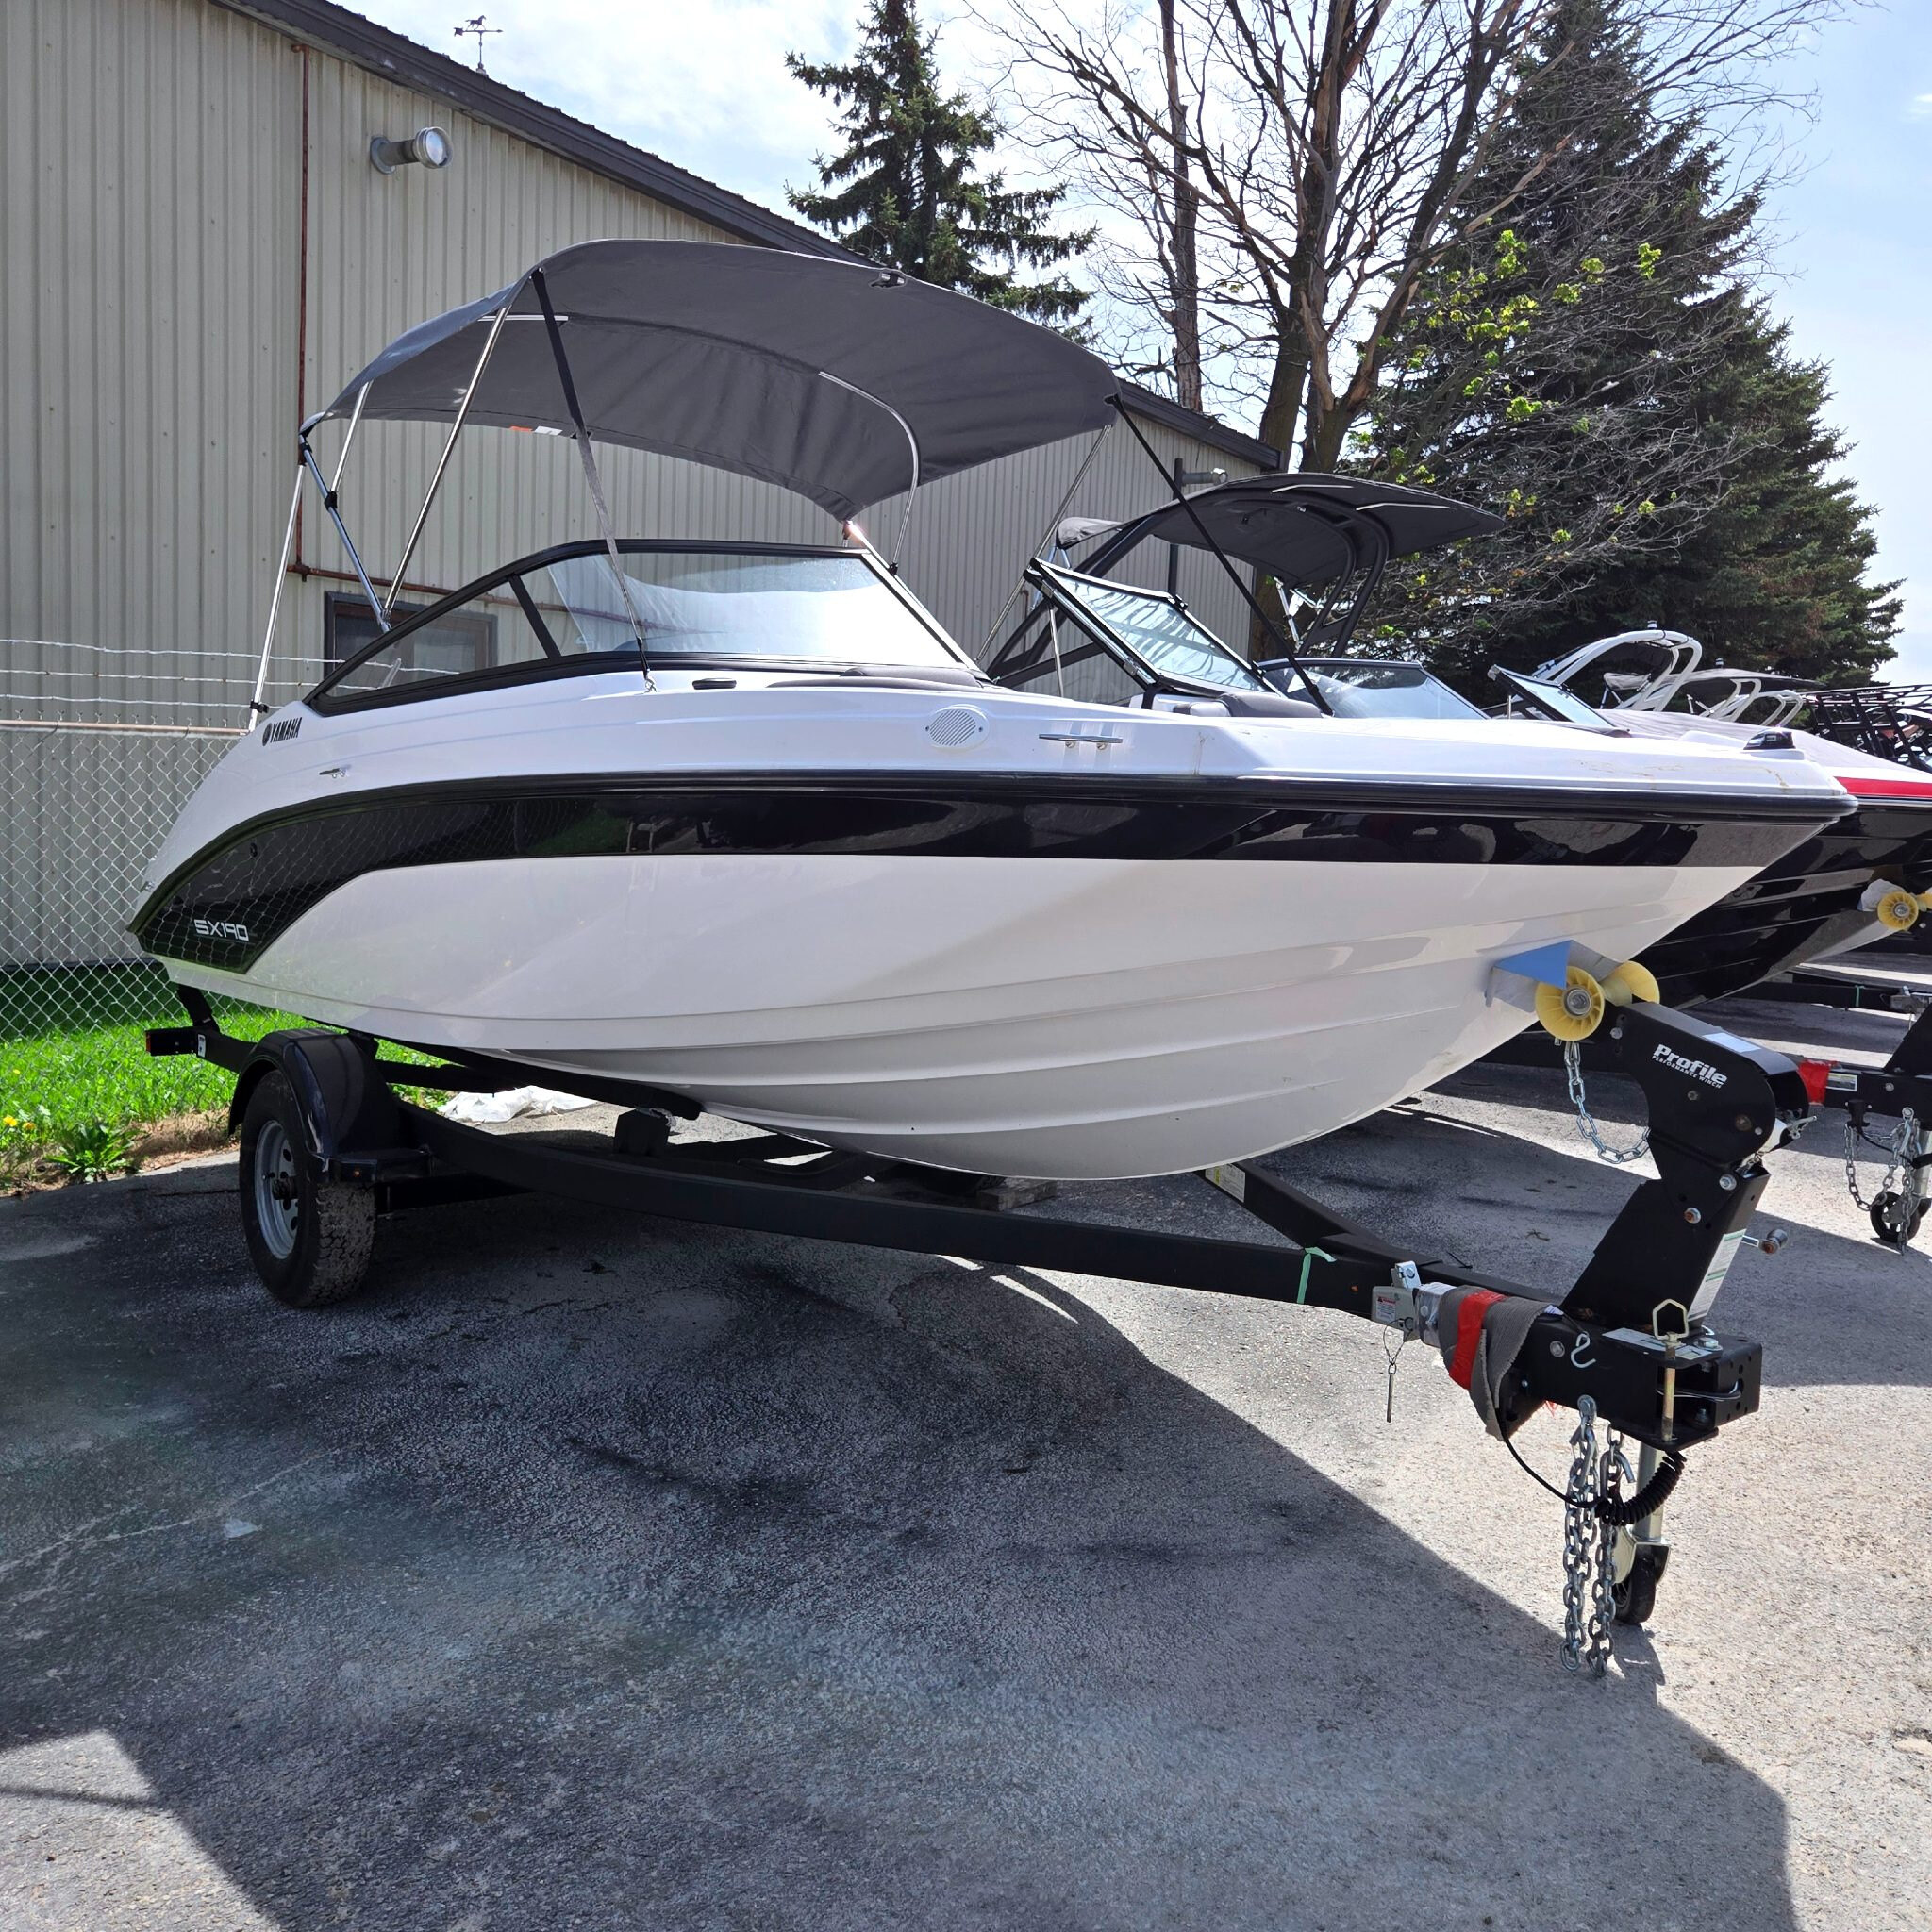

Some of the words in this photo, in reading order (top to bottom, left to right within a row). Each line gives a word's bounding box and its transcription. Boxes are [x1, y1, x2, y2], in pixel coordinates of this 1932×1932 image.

[270, 717, 303, 743] YAMAHA
[193, 919, 250, 941] SX190
[1651, 1055, 1698, 1078] PERFORMANCE
[1698, 1075, 1722, 1089] WINCH
[1653, 1043, 1728, 1085] Profile
